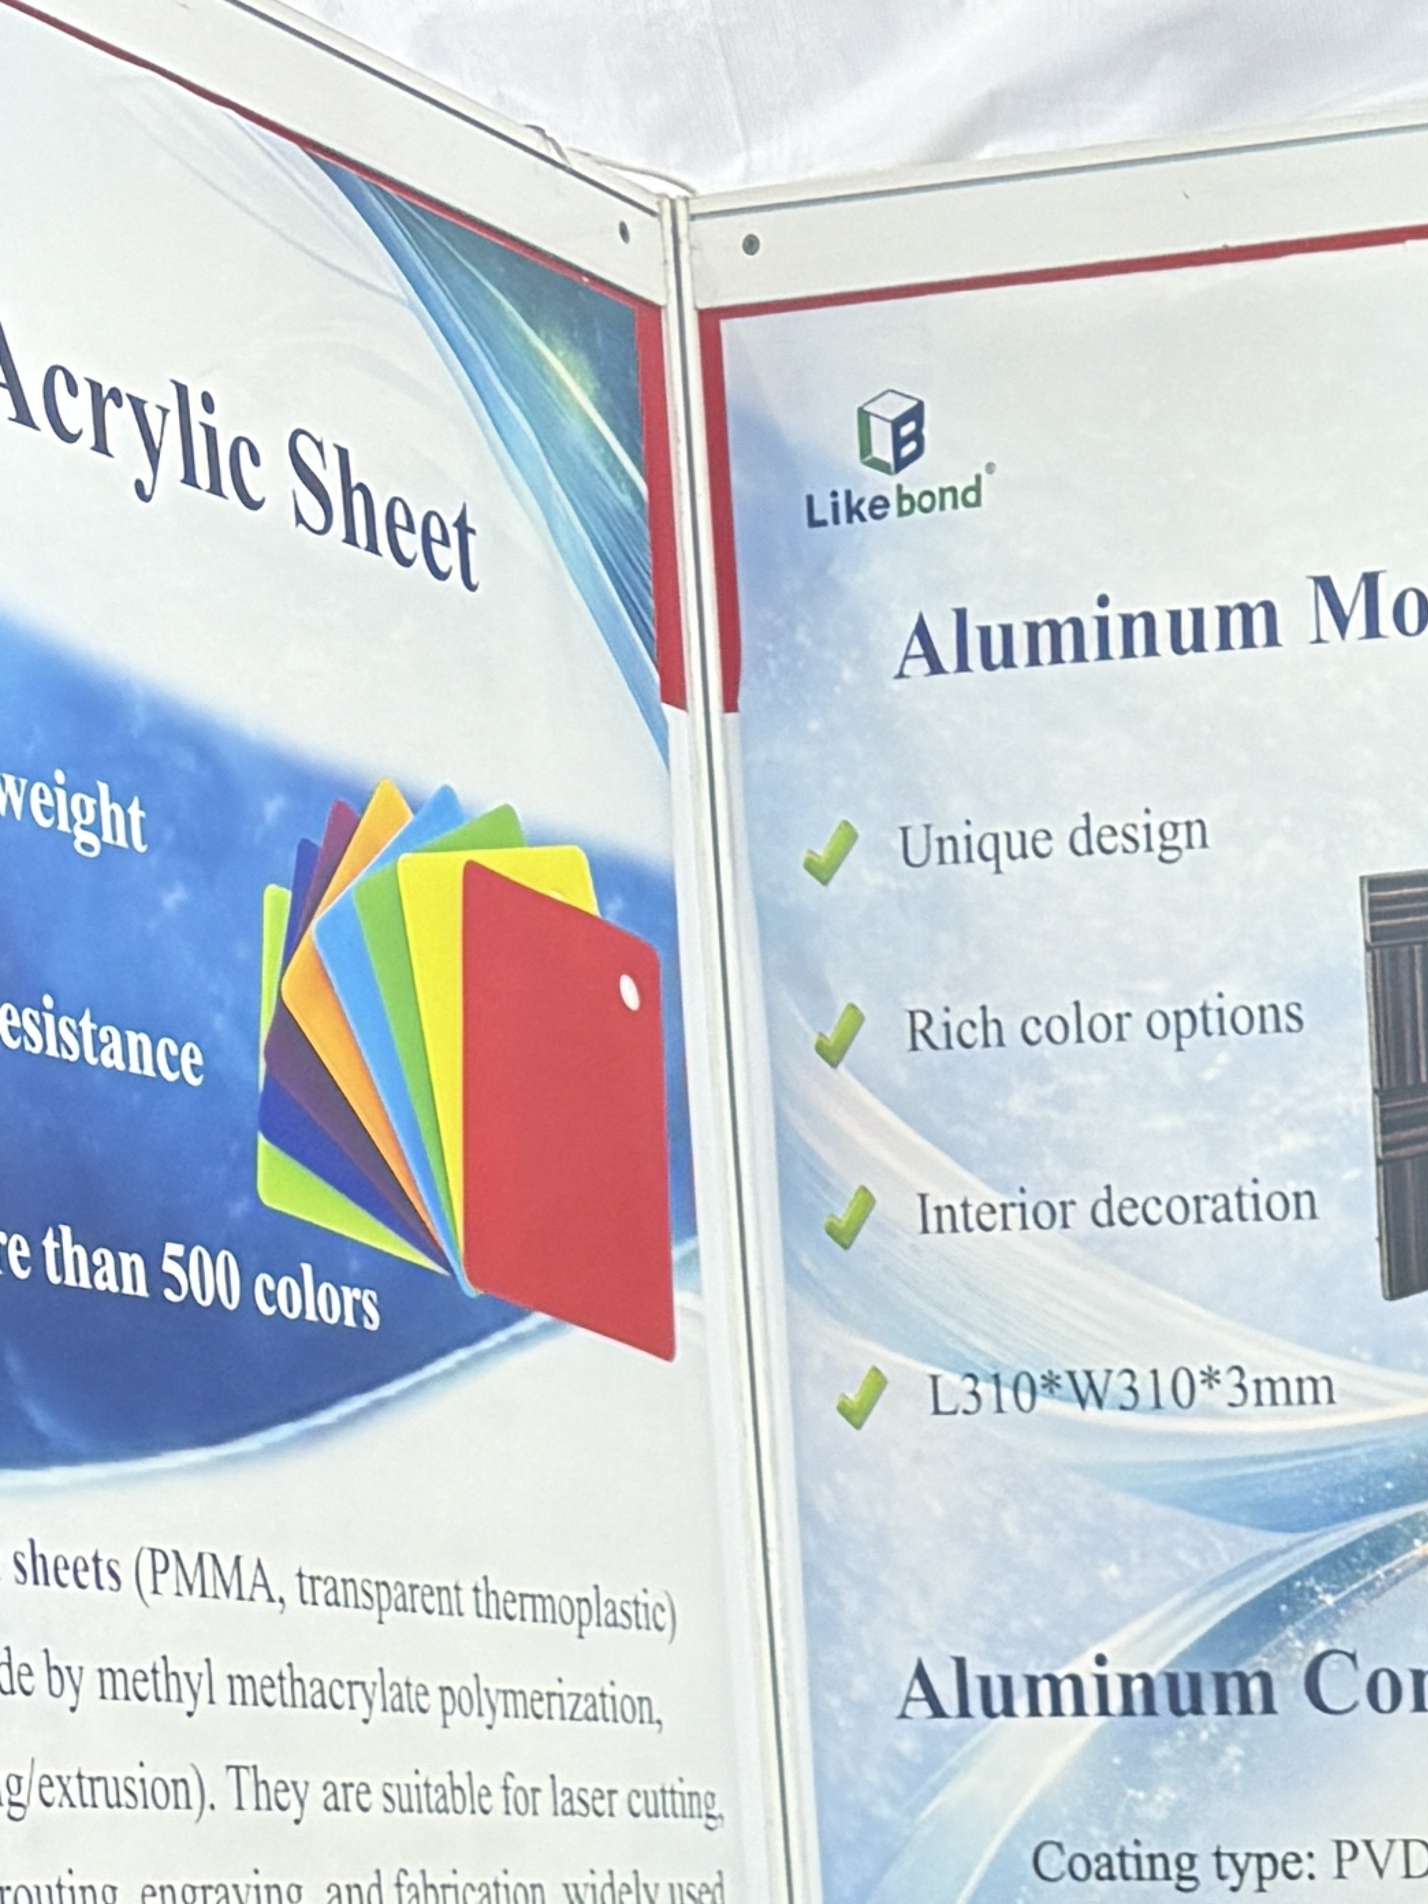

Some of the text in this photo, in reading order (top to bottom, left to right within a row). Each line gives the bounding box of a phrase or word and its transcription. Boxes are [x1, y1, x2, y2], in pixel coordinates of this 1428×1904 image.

[287, 427, 480, 593] Sheet
[893, 593, 1283, 680] Aluminum
[898, 807, 1209, 875] Unique design
[907, 991, 1304, 1053] Rich color options
[916, 1177, 1319, 1235] Interior decoration
[41, 1224, 381, 1331] than 500 colors
[12, 1537, 677, 1644] sheets (PMMA, transparent thermoplastic)
[42, 1647, 663, 1734] by methyl methacrylate polymerization,
[896, 1652, 1279, 1720] Aluminum
[225, 1764, 725, 1832] They are suitable for laser cutting,
[1031, 1838, 1201, 1894] Coating
[1211, 1844, 1316, 1893] type:
